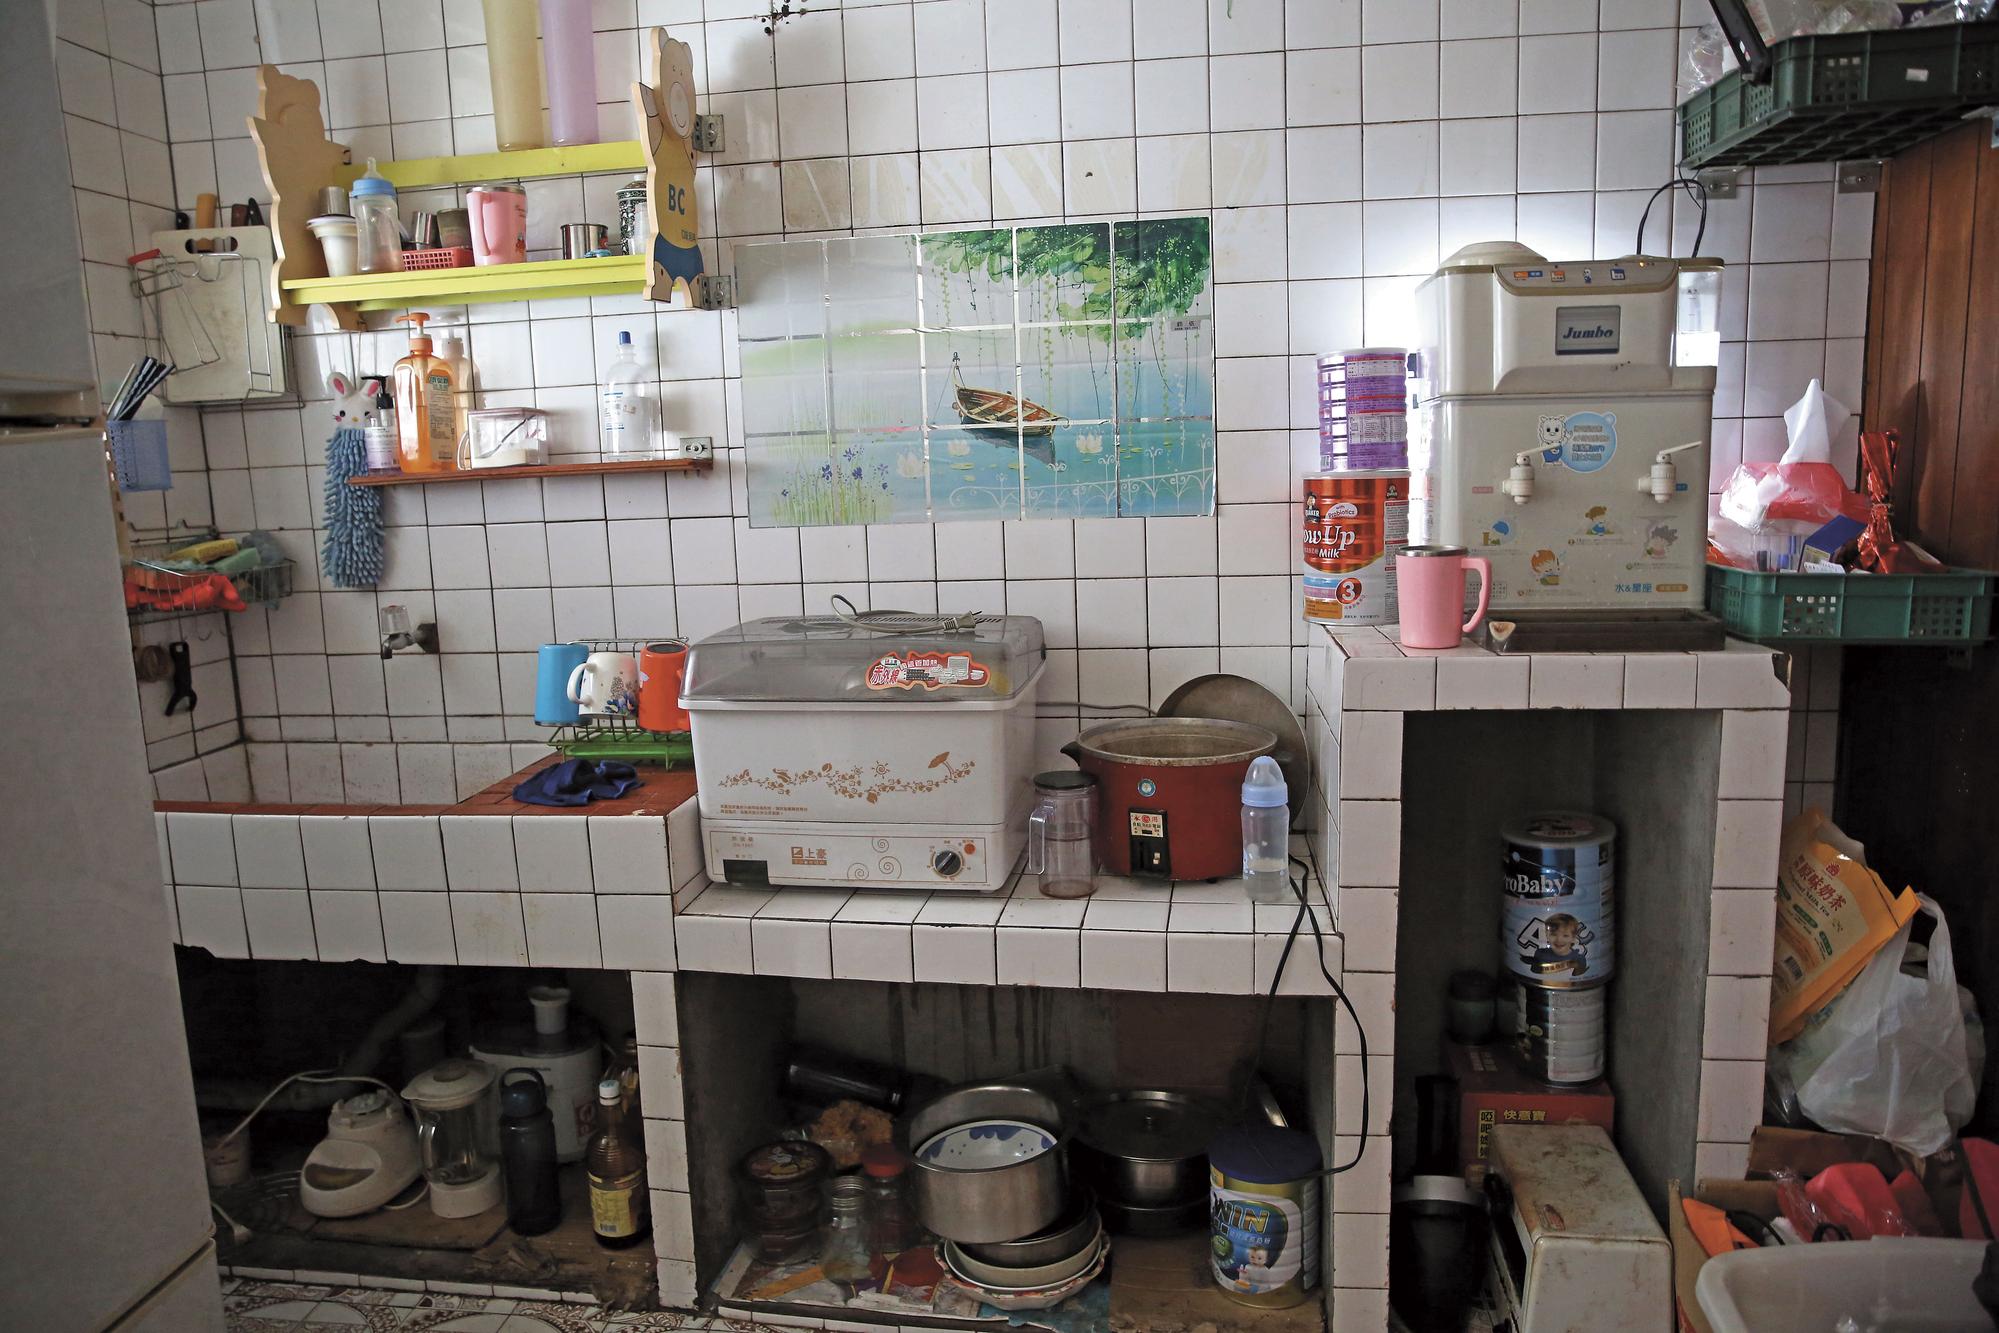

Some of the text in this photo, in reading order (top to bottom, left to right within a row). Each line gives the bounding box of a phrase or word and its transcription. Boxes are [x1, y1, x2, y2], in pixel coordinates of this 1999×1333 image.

[668, 183, 686, 216] BC
[1563, 325, 1615, 340] Jumbo
[1328, 509, 1355, 518] Probiotics
[1319, 548, 1339, 558] Milk
[1342, 581, 1355, 601] 3
[1503, 873, 1566, 897] roBaby
